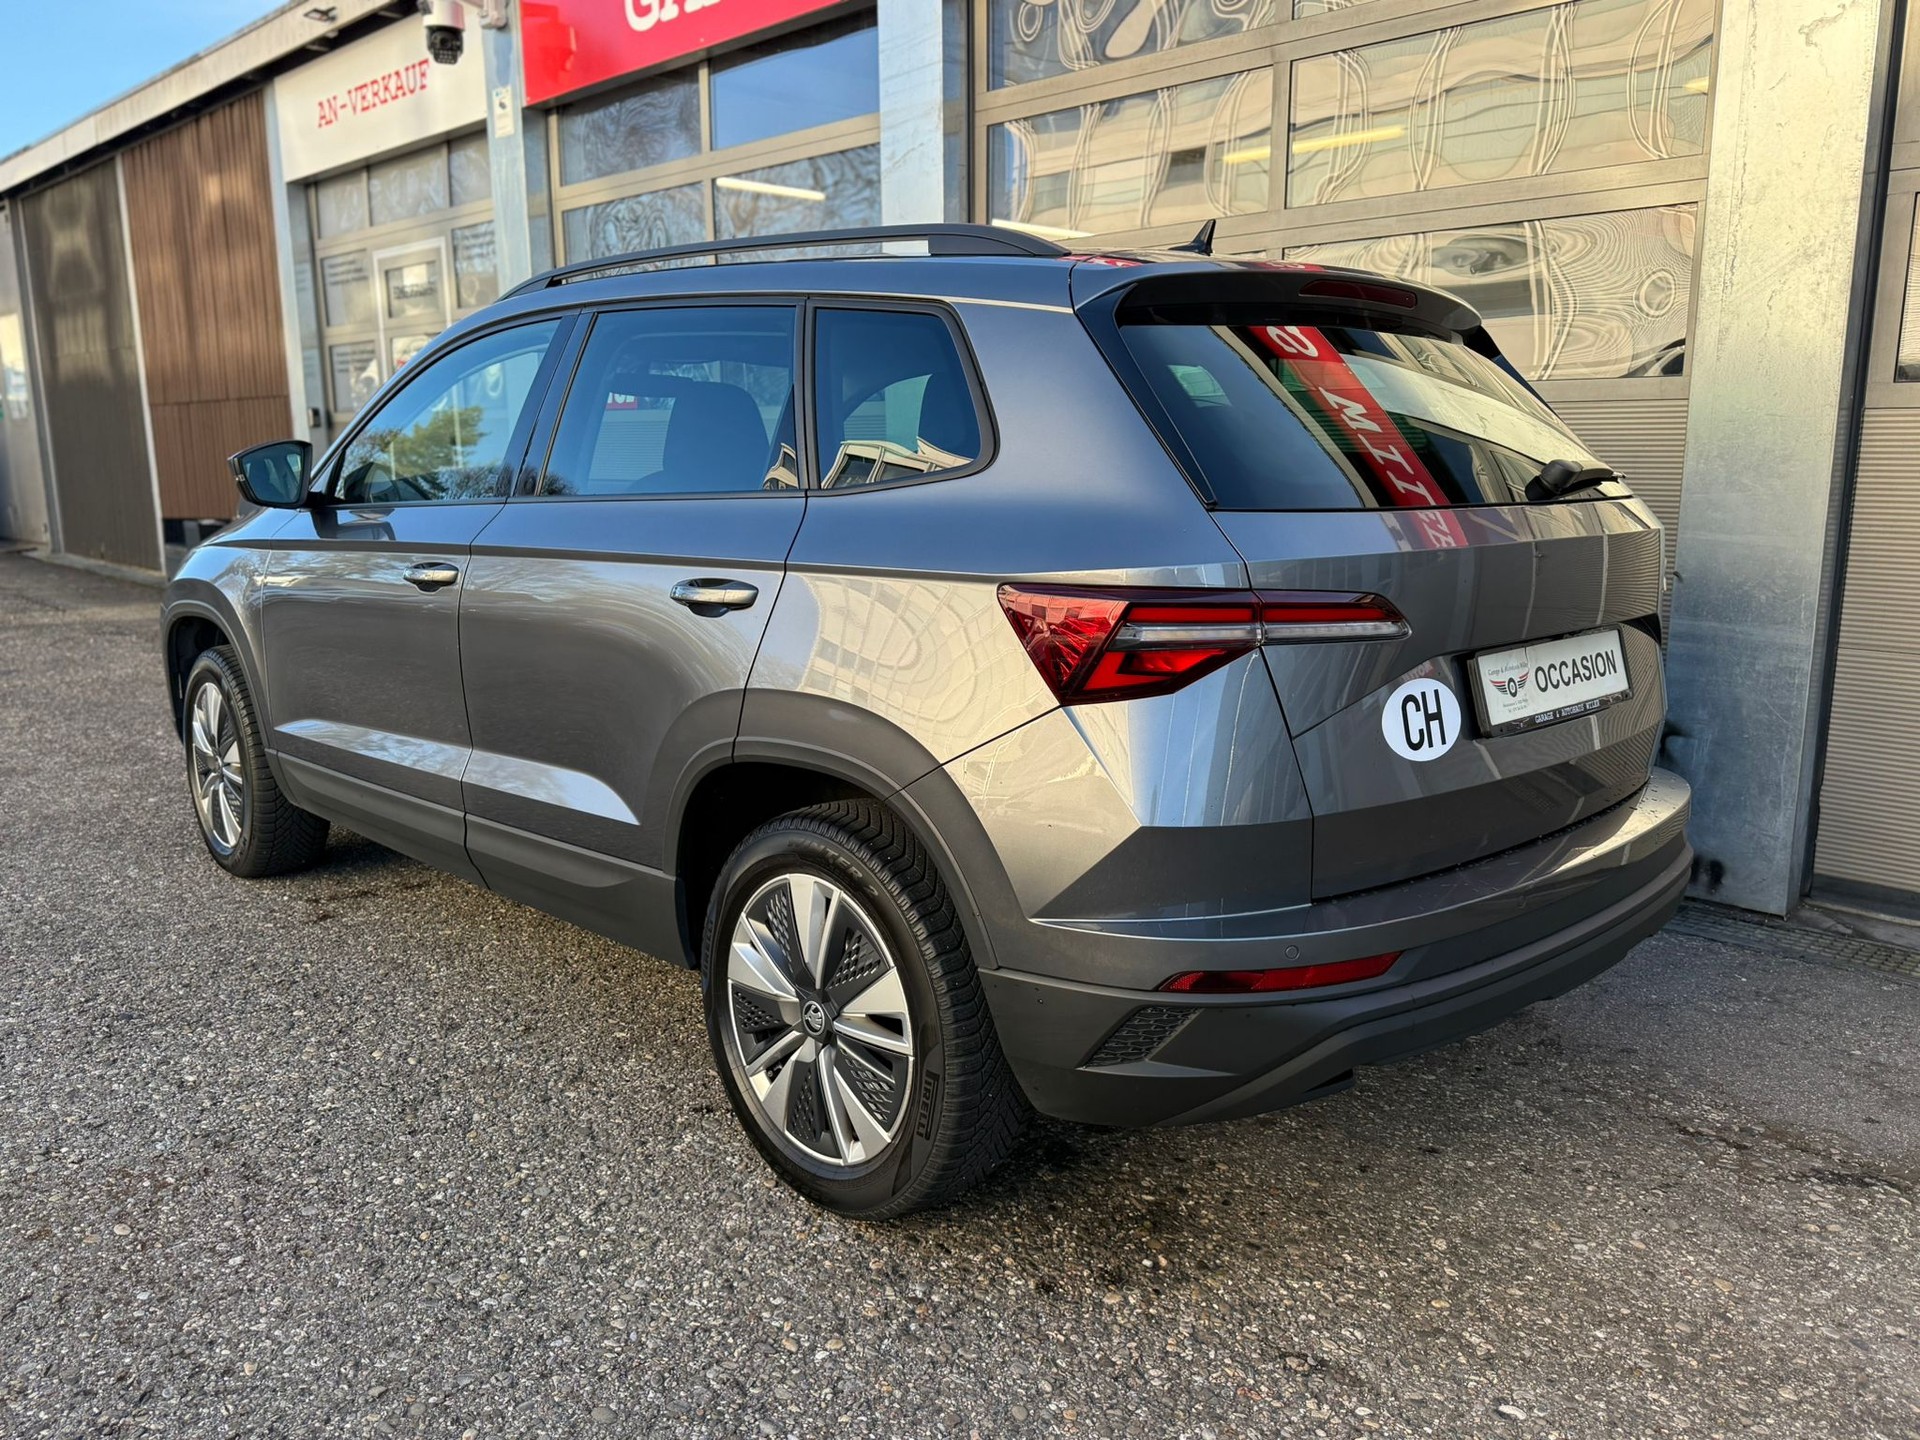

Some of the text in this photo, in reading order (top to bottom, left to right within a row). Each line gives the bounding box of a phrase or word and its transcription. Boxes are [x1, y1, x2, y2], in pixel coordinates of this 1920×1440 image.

[318, 58, 430, 128] AN-VERKAUF
[1534, 649, 1618, 693] OCCASION
[1401, 688, 1447, 751] CH
[916, 1069, 941, 1141] PIRELLI
